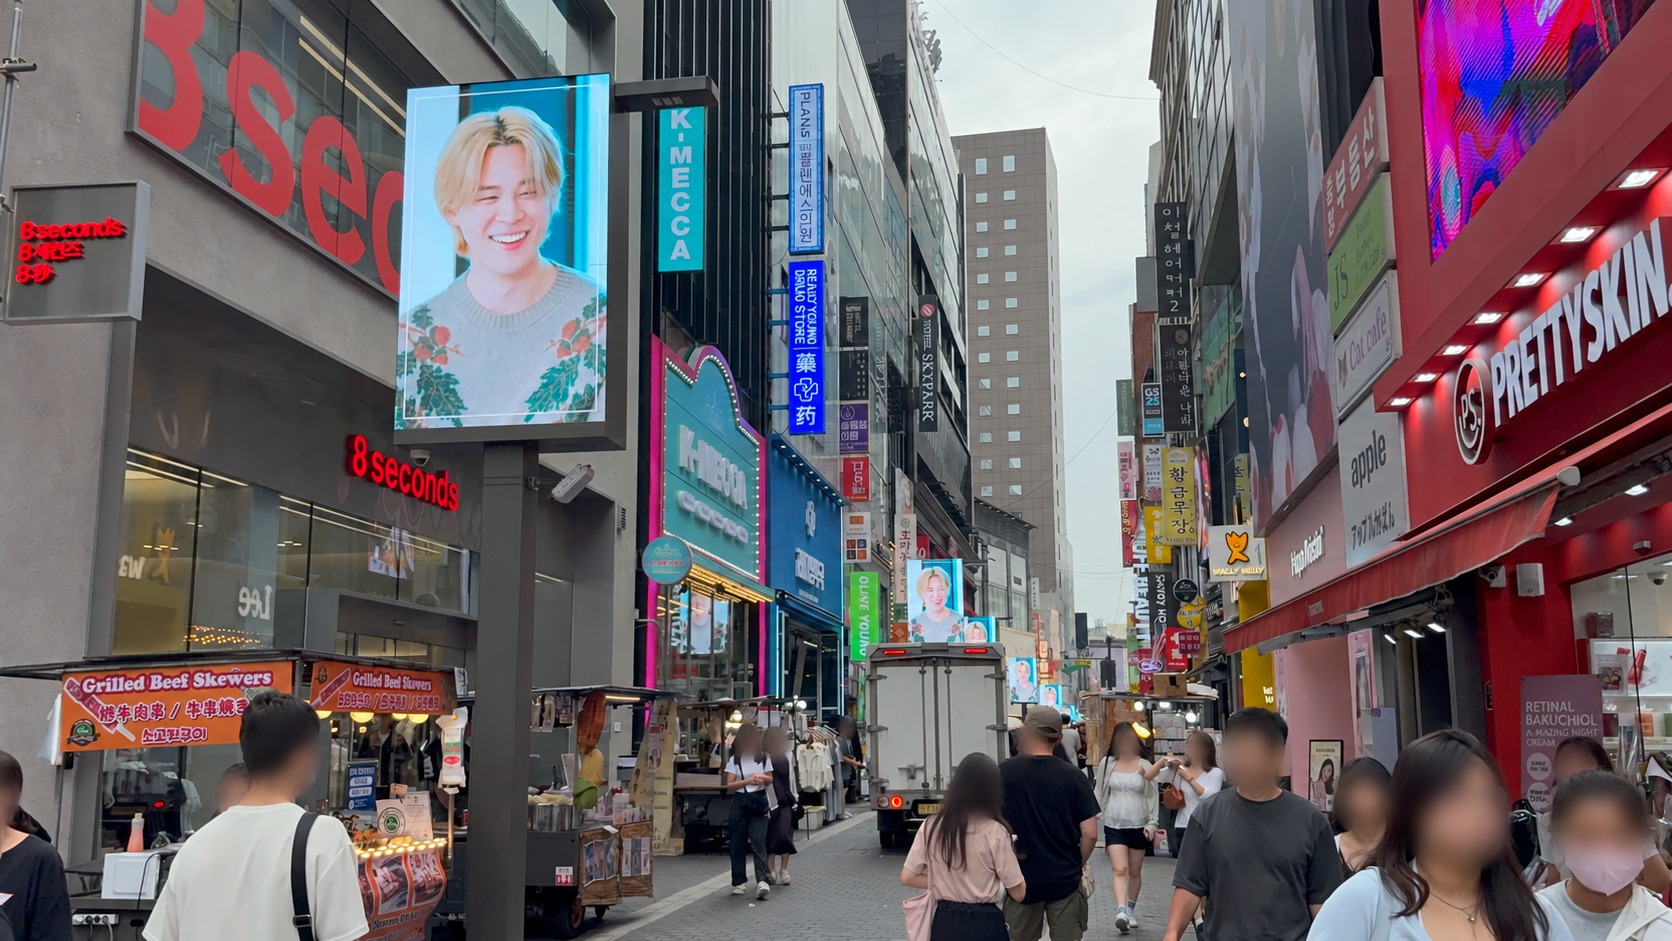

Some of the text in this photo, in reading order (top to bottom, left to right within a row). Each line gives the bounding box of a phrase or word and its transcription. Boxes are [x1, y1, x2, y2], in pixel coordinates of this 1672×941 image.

[670, 109, 692, 260] K-MECCA
[36, 217, 123, 239] seconds
[794, 305, 805, 344] STORE
[1349, 335, 1365, 371] Cat
[1366, 306, 1387, 351] cafe
[796, 353, 816, 373] 藥
[922, 354, 934, 421] SKYPARK
[1145, 387, 1160, 397] GS
[1145, 397, 1160, 406] 25
[796, 406, 816, 426] 药
[1351, 429, 1387, 488] apple
[350, 434, 460, 511] 8 seconds
[82, 671, 272, 694] Grilled Beef Skewers
[353, 672, 383, 688] Grilled
[384, 674, 401, 688] Beef
[1526, 701, 1575, 712] RETINAL
[1526, 714, 1598, 726] BAKUCHIOL
[1572, 728, 1598, 737] NIGHT
